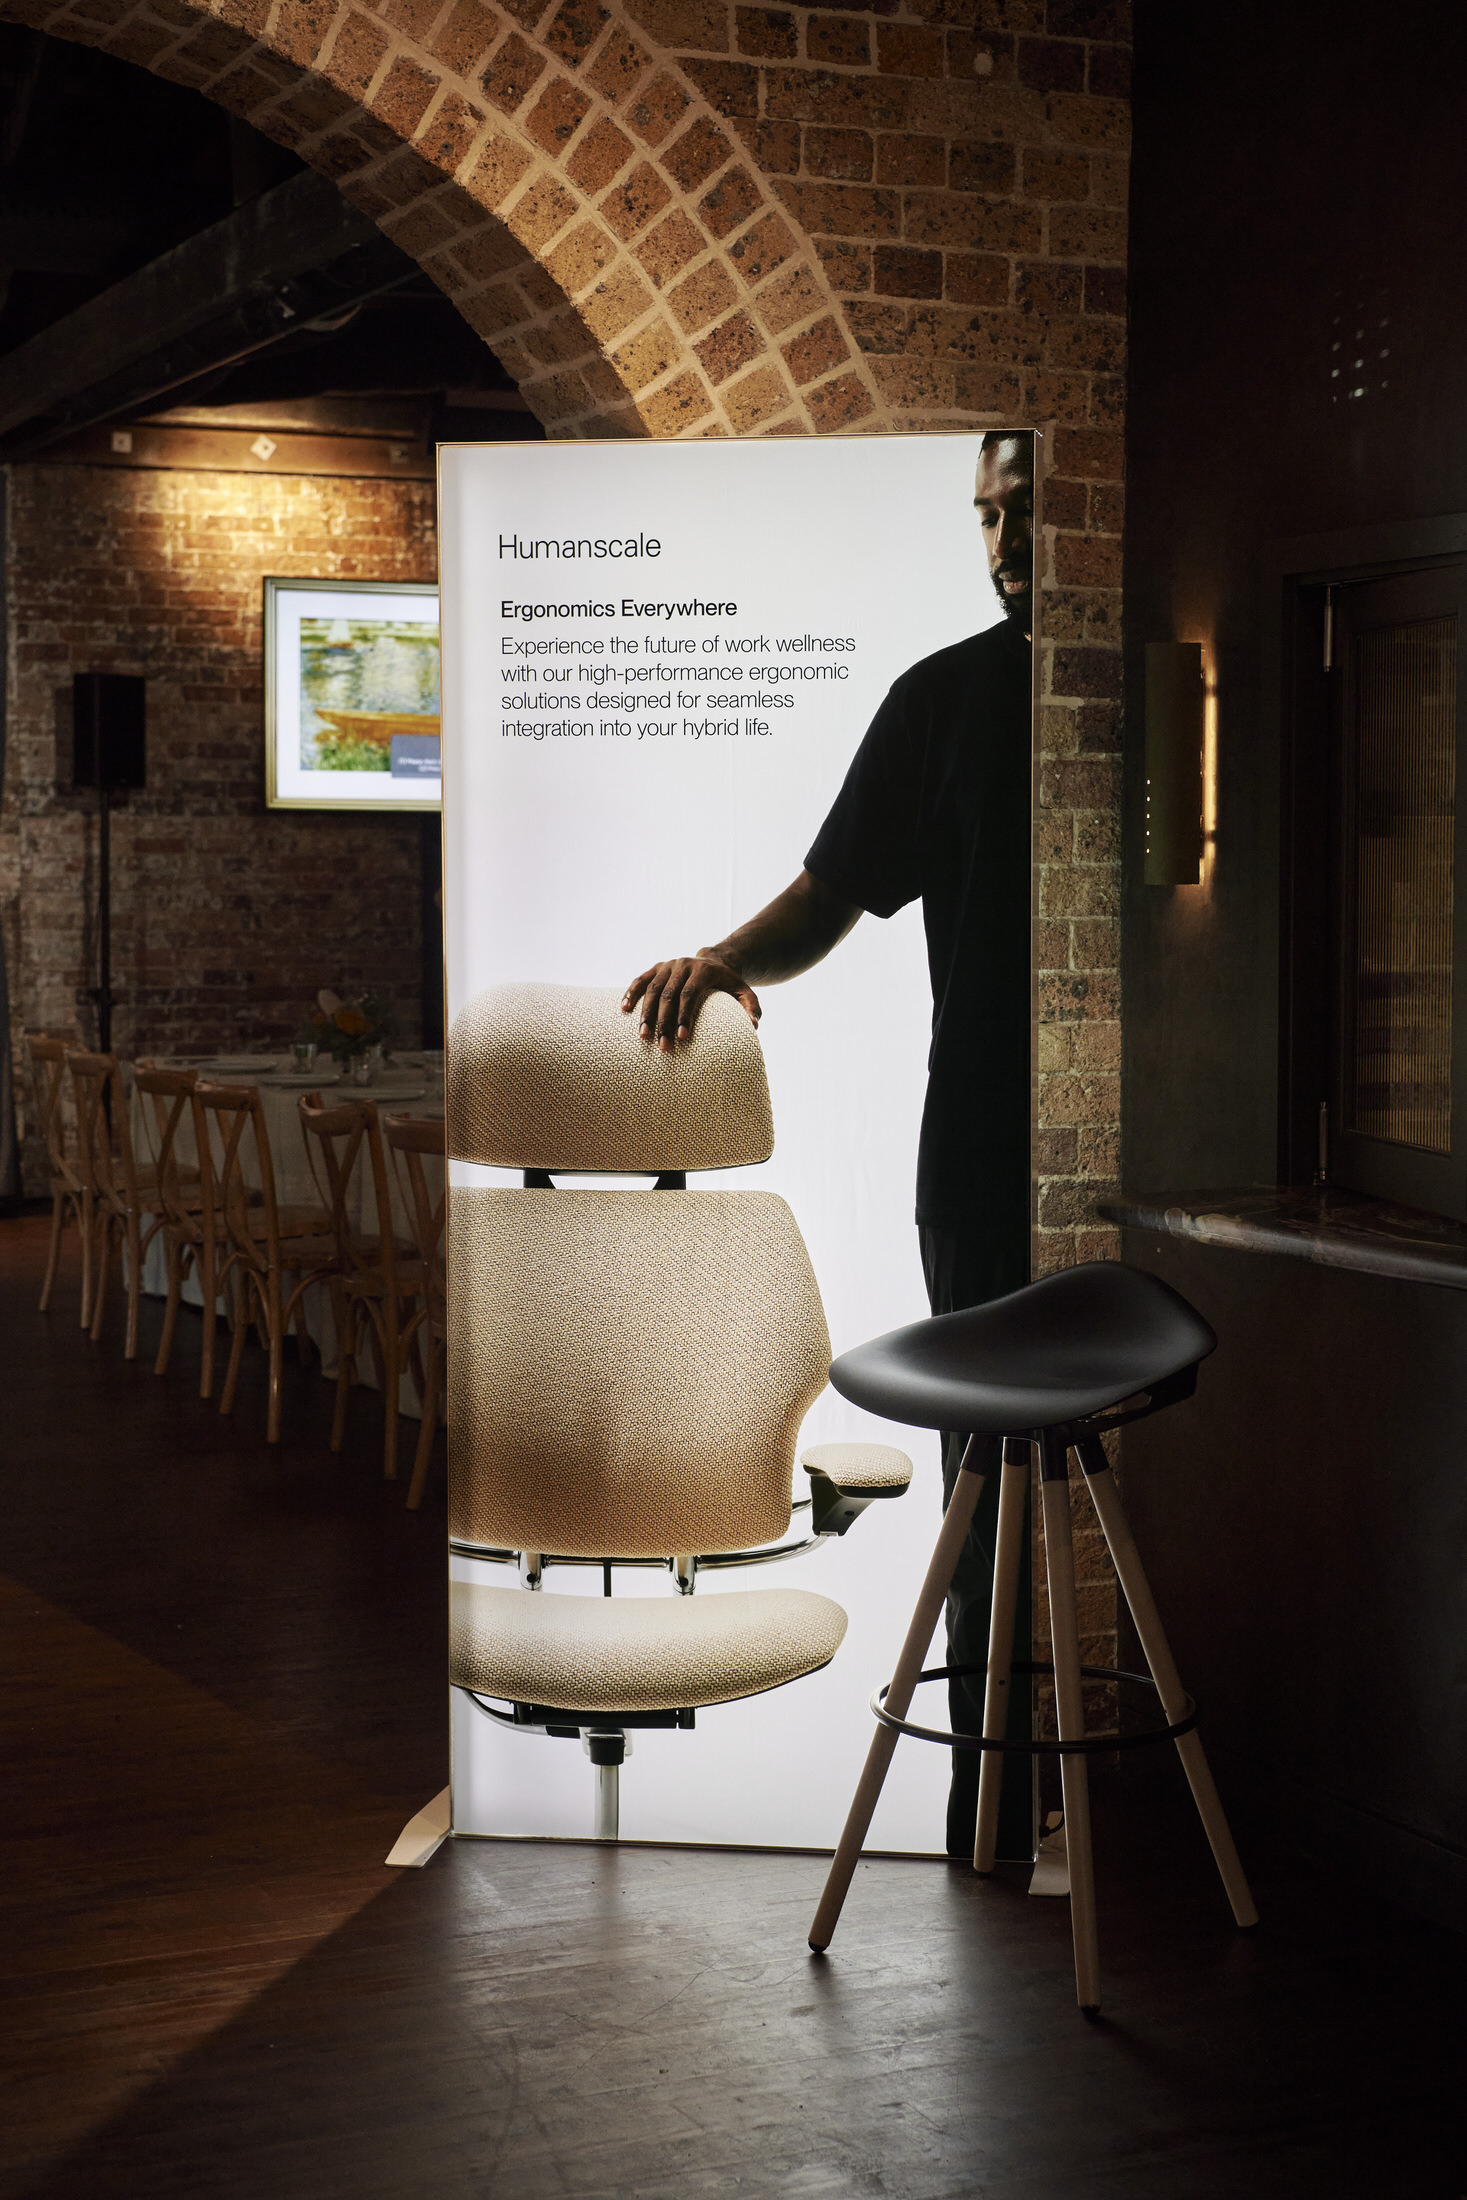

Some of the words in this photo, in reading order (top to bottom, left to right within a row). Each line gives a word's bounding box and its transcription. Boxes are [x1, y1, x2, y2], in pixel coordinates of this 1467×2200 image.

[498, 531, 662, 560] Humanscale
[501, 599, 616, 623] Ergonomics
[621, 597, 738, 621] Everywhere
[501, 636, 605, 659] Experience
[609, 635, 639, 655] the
[643, 635, 697, 654] future
[701, 634, 720, 654] of
[724, 634, 772, 654] work
[775, 633, 856, 653] wellness
[500, 663, 538, 683] with
[542, 667, 574, 683] our
[578, 662, 744, 686] high-performance
[748, 661, 849, 685] ergonomic
[501, 691, 582, 710] solutions
[586, 690, 671, 713] designed
[676, 689, 702, 709] for
[706, 689, 795, 709] seamless
[501, 718, 594, 741] integration
[599, 718, 632, 737] into
[636, 722, 678, 741] your
[683, 717, 739, 740] hybrid
[745, 717, 773, 737] life.
